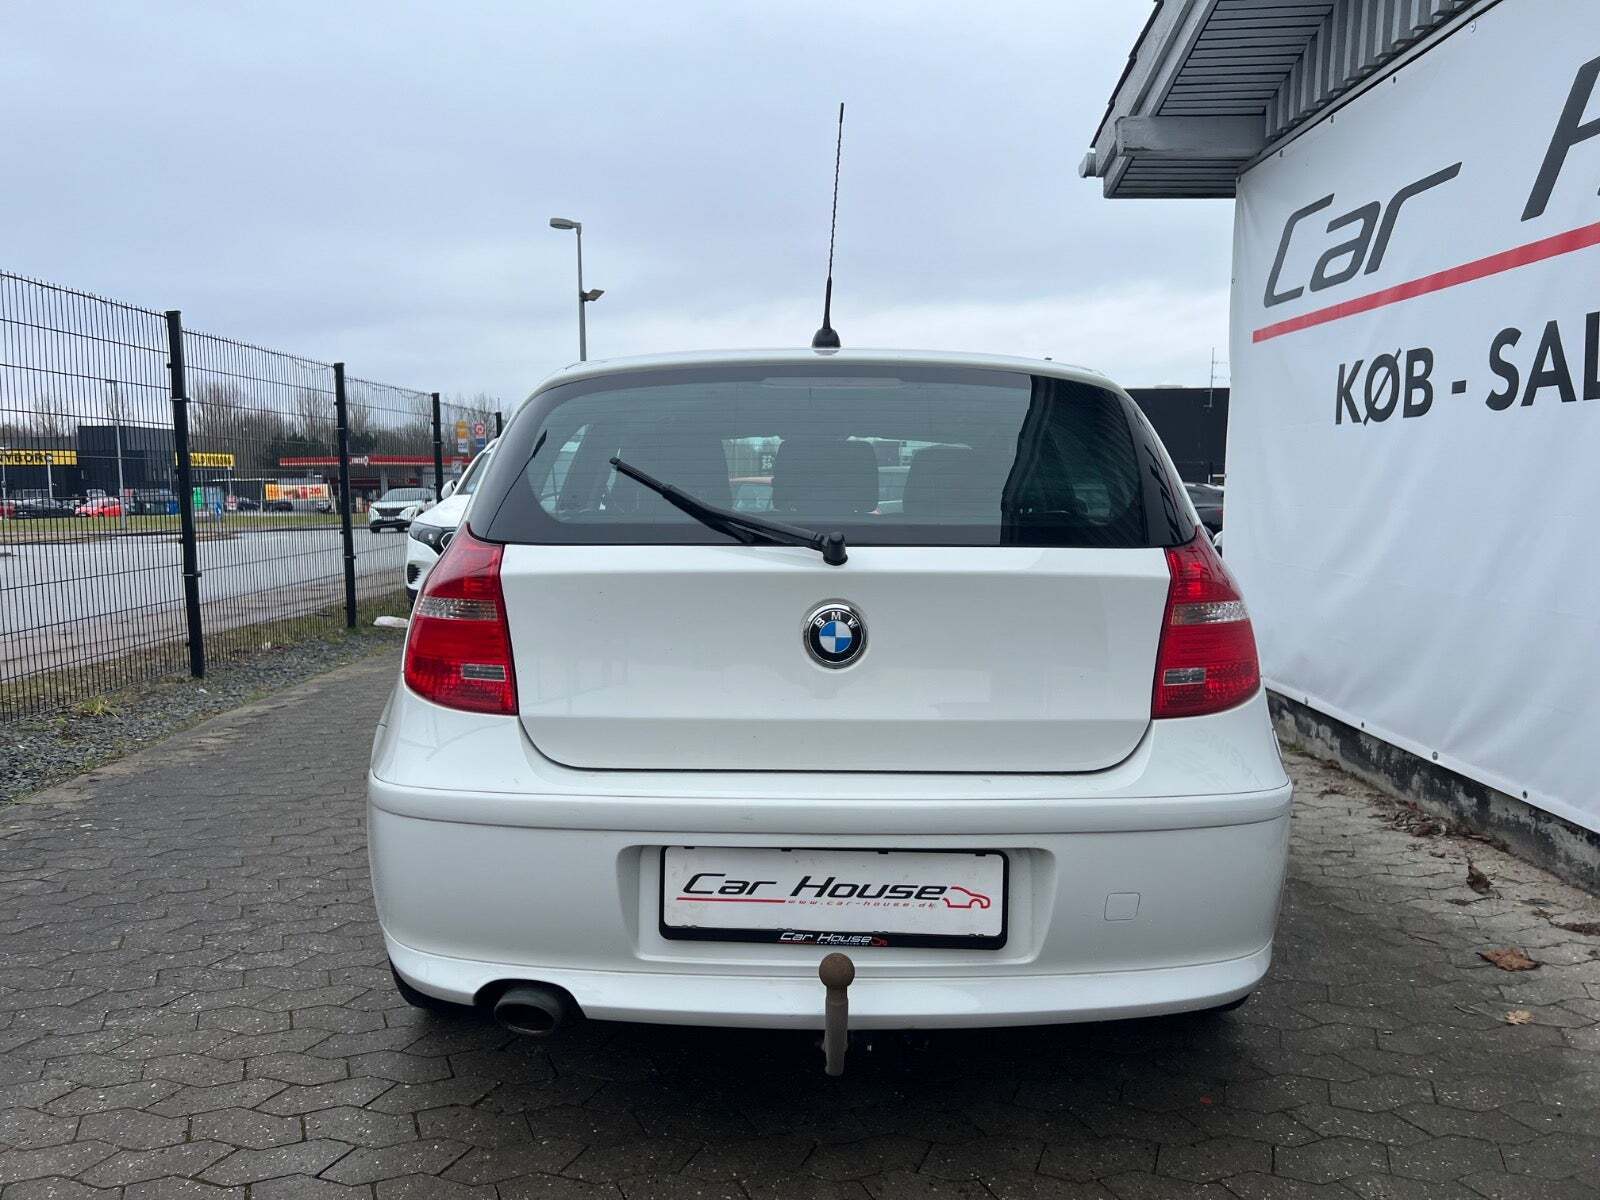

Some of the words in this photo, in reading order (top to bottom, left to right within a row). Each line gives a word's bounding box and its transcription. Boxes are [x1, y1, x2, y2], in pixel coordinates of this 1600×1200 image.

[1263, 161, 1462, 308] Car
[1335, 347, 1435, 426] KØB
[814, 611, 859, 629] BMW
[682, 872, 778, 896] Car
[789, 875, 948, 900] House
[780, 932, 814, 941] Car
[817, 933, 873, 943] House
